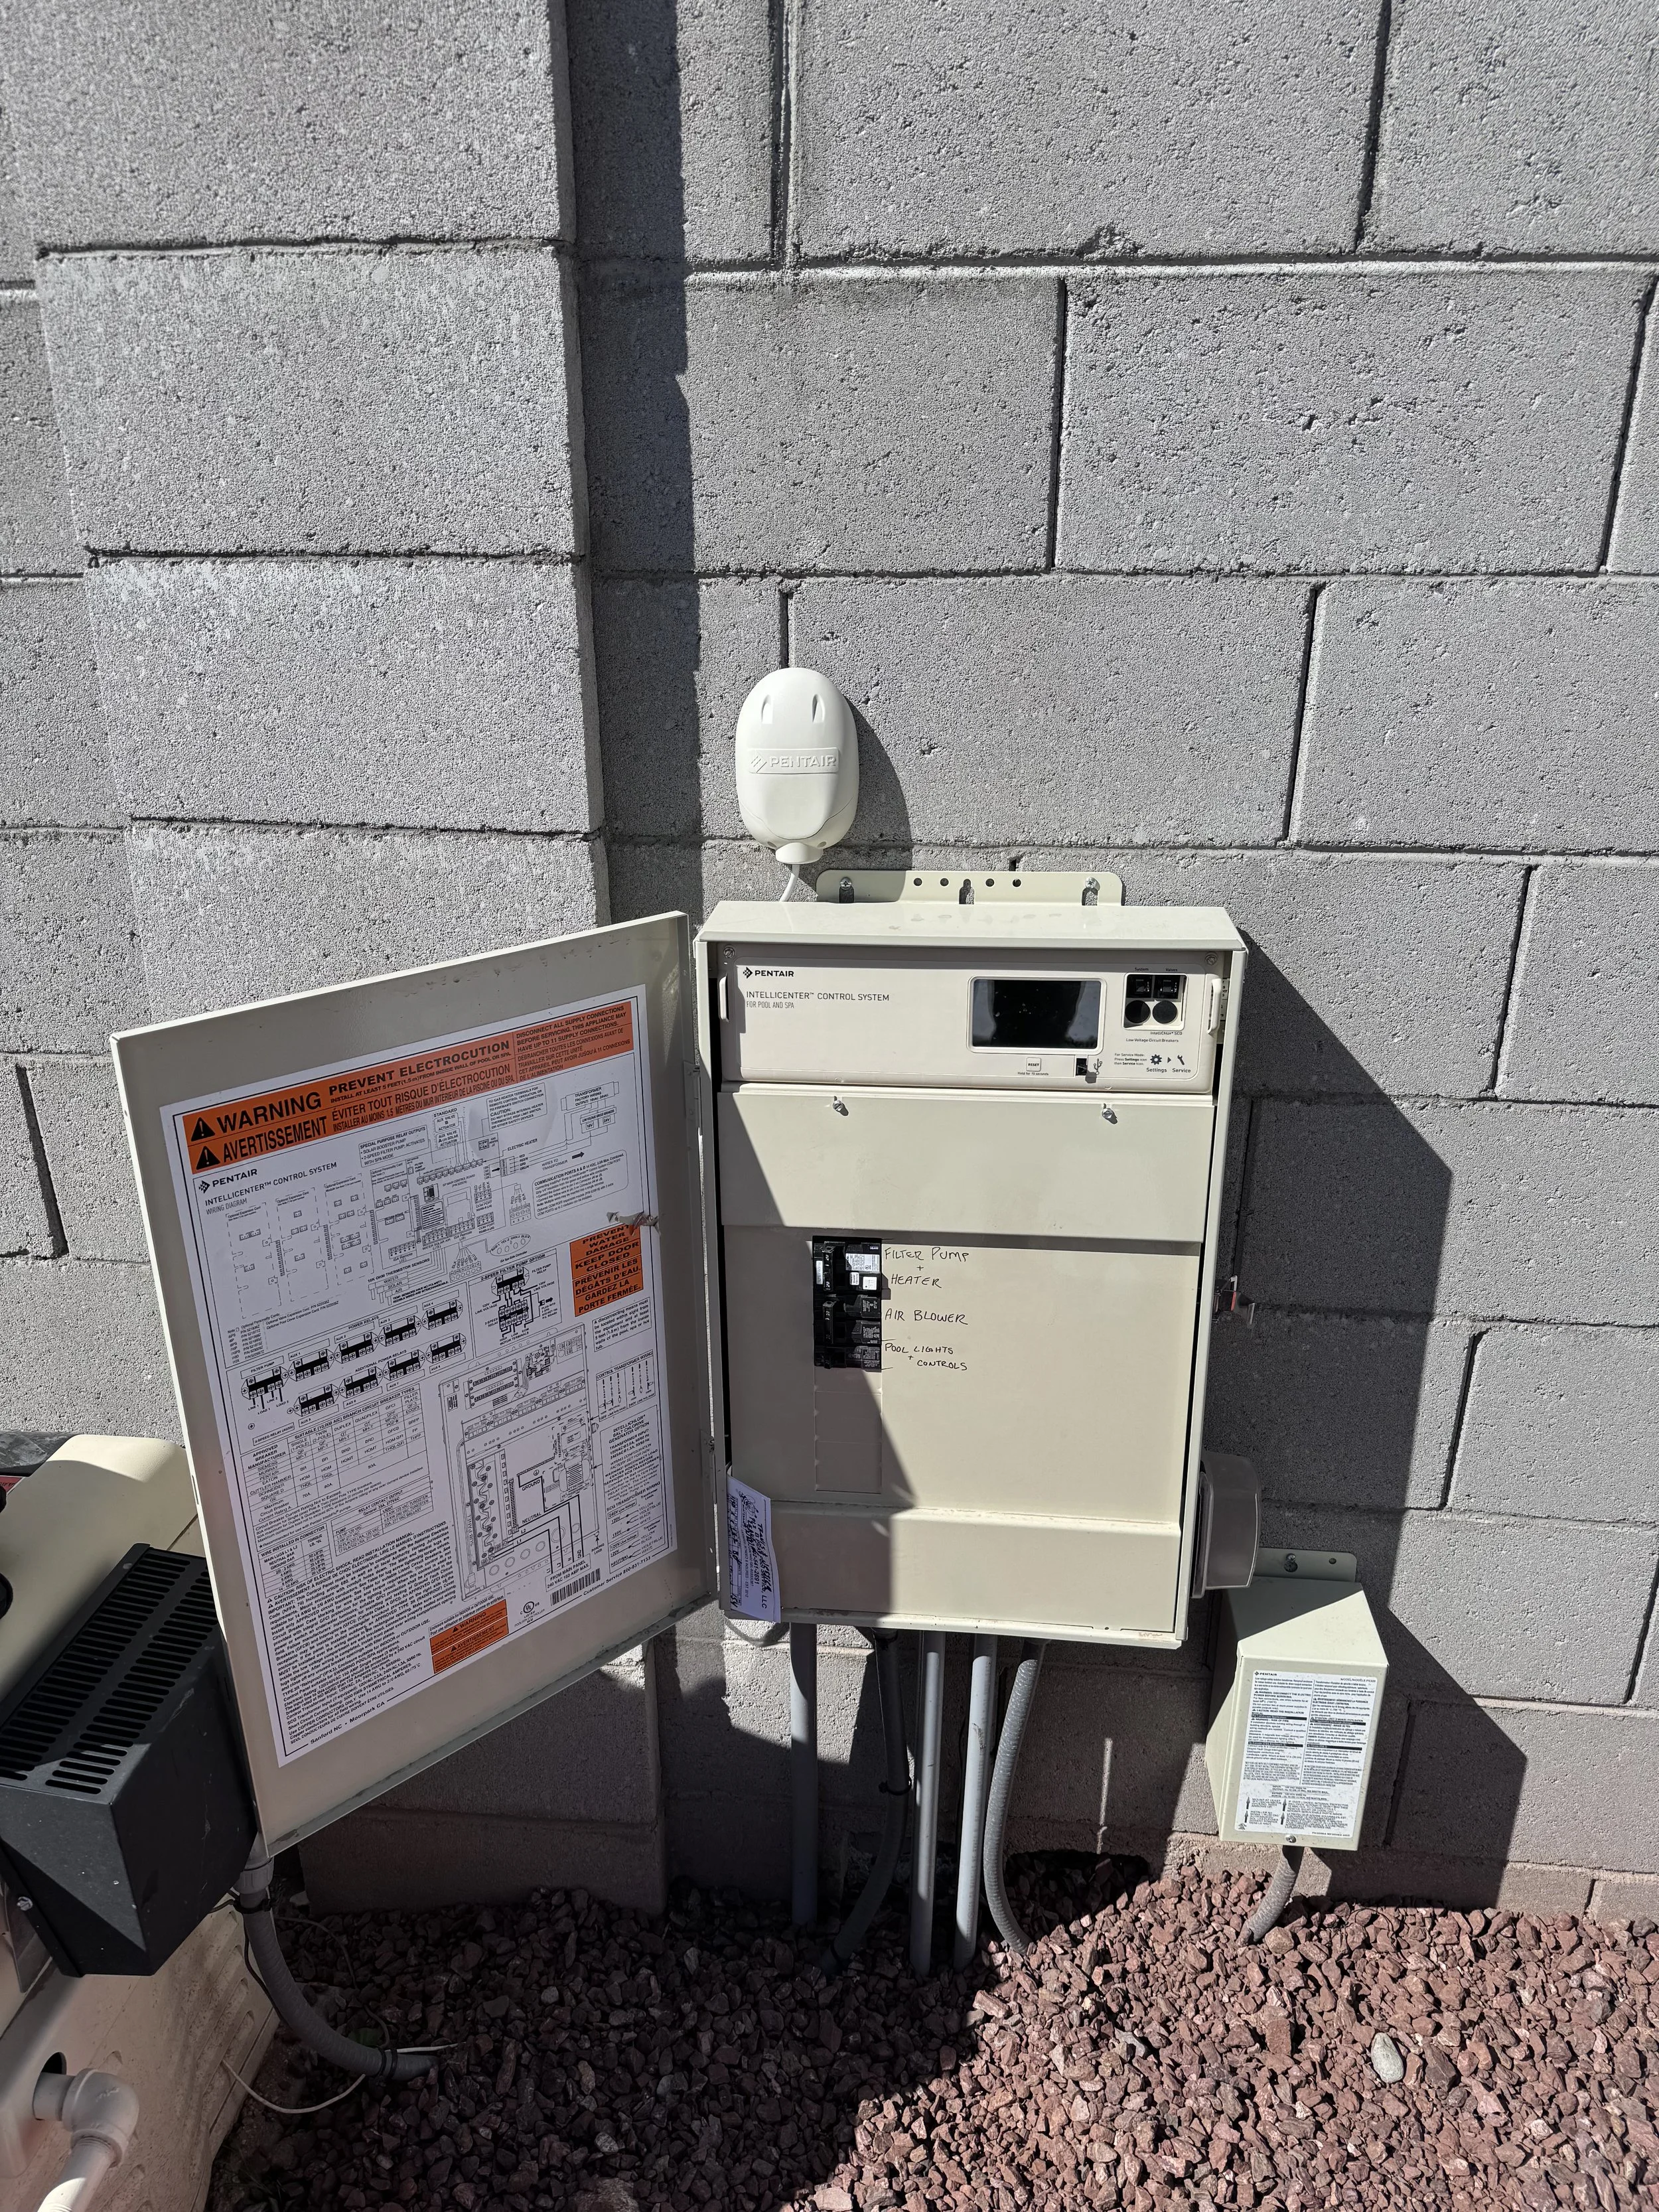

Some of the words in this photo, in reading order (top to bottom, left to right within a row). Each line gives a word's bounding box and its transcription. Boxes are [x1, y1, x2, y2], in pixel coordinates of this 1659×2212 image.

[769, 755, 836, 768] PENTAIR
[516, 1023, 552, 1039] DISCONNECT
[553, 1020, 564, 1029] ALL
[565, 1015, 585, 1026] SUPPLY
[586, 1005, 624, 1021] CONNECTIONS
[516, 1034, 540, 1046] BEFORE
[571, 1022, 584, 1031] THIS
[585, 1014, 614, 1028] APPLIANCE
[615, 1011, 626, 1019] MAY
[517, 1043, 533, 1053] HAVE
[557, 1031, 579, 1042] SUPPLY
[579, 1020, 618, 1037] CONNECTIONS.
[548, 1043, 566, 1053] TOUTES
[566, 1040, 575, 1049] LES
[575, 1032, 603, 1046] CONNEXIONS
[603, 1029, 617, 1038] AVANT
[328, 1070, 394, 1096] PREVENT
[399, 1039, 510, 1078] ELECTROCUTION
[330, 1092, 355, 1104] INSTALL
[363, 1085, 382, 1095] LEAST
[386, 1080, 401, 1089] FEET
[419, 1071, 435, 1080] FROM
[435, 1066, 455, 1076] INSIDE
[454, 1062, 469, 1070] WALL
[477, 1056, 491, 1065] POOL
[331, 1100, 366, 1122] ÉVITER
[367, 1094, 394, 1112] TOUT
[394, 1084, 429, 1105] RISQUE
[430, 1061, 510, 1094] D'ÉLECTROCUTION
[216, 1090, 323, 1136] WARNING
[332, 1116, 360, 1132] INSTALLER
[360, 1114, 368, 1124] AU
[368, 1110, 385, 1122] MOINS
[415, 1099, 423, 1109] DU
[422, 1096, 433, 1107] MUR
[458, 1087, 466, 1097] DE
[465, 1085, 472, 1095] LA
[472, 1080, 490, 1093] PISCINE
[490, 1078, 498, 1088] OU
[497, 1076, 505, 1086] DU
[433, 1107, 457, 1118] STANDARD
[490, 1106, 512, 1118] CAUTION:
[220, 1115, 328, 1163] AVERTISSEMENT
[359, 1140, 376, 1149] SPECIAL
[376, 1135, 395, 1145] PURPOSE
[408, 1126, 426, 1136] OUTPUTS
[376, 1141, 395, 1150] BOOSTER
[211, 1167, 258, 1188] PENTAIR
[273, 1169, 308, 1187] CONTROL
[309, 1161, 337, 1176] SYSTEM
[206, 1203, 225, 1216] WIRING
[224, 1197, 248, 1210] DIAGRAM
[582, 1222, 630, 1246] PREVENT
[585, 1235, 629, 1256] DAMAGE
[589, 1230, 625, 1249] WATER
[575, 1252, 605, 1270] KEEP
[607, 1240, 639, 1258] DOOR
[586, 1251, 630, 1273] CLOSED
[885, 1247, 924, 1260] FILTER
[574, 1263, 619, 1288] PRÉVENIR
[622, 1257, 638, 1269] LES
[891, 1274, 942, 1288] HEATER
[585, 1282, 617, 1302] GARDEZ
[618, 1278, 630, 1288] LA
[578, 1296, 605, 1313] PORTE
[885, 1308, 905, 1321] AIR
[914, 1309, 968, 1325] BLOWER
[885, 1343, 908, 1353] POOL
[914, 1345, 954, 1355] LIGHTS
[917, 1359, 968, 1371] CONTROLS
[522, 1479, 540, 1491] GROUND
[522, 1511, 541, 1524] NEUTRAL
[549, 1572, 561, 1582] FROM
[561, 1566, 573, 1575] MAIN
[572, 1559, 585, 1570] PANEL
[459, 1610, 486, 1629] WARNING
[457, 1624, 495, 1649] AVERTISSEMENT
[310, 1728, 333, 1745] Sanford
[333, 1723, 342, 1733] NC
[349, 1705, 376, 1724] Moorpark
[376, 1700, 385, 1710] CA
